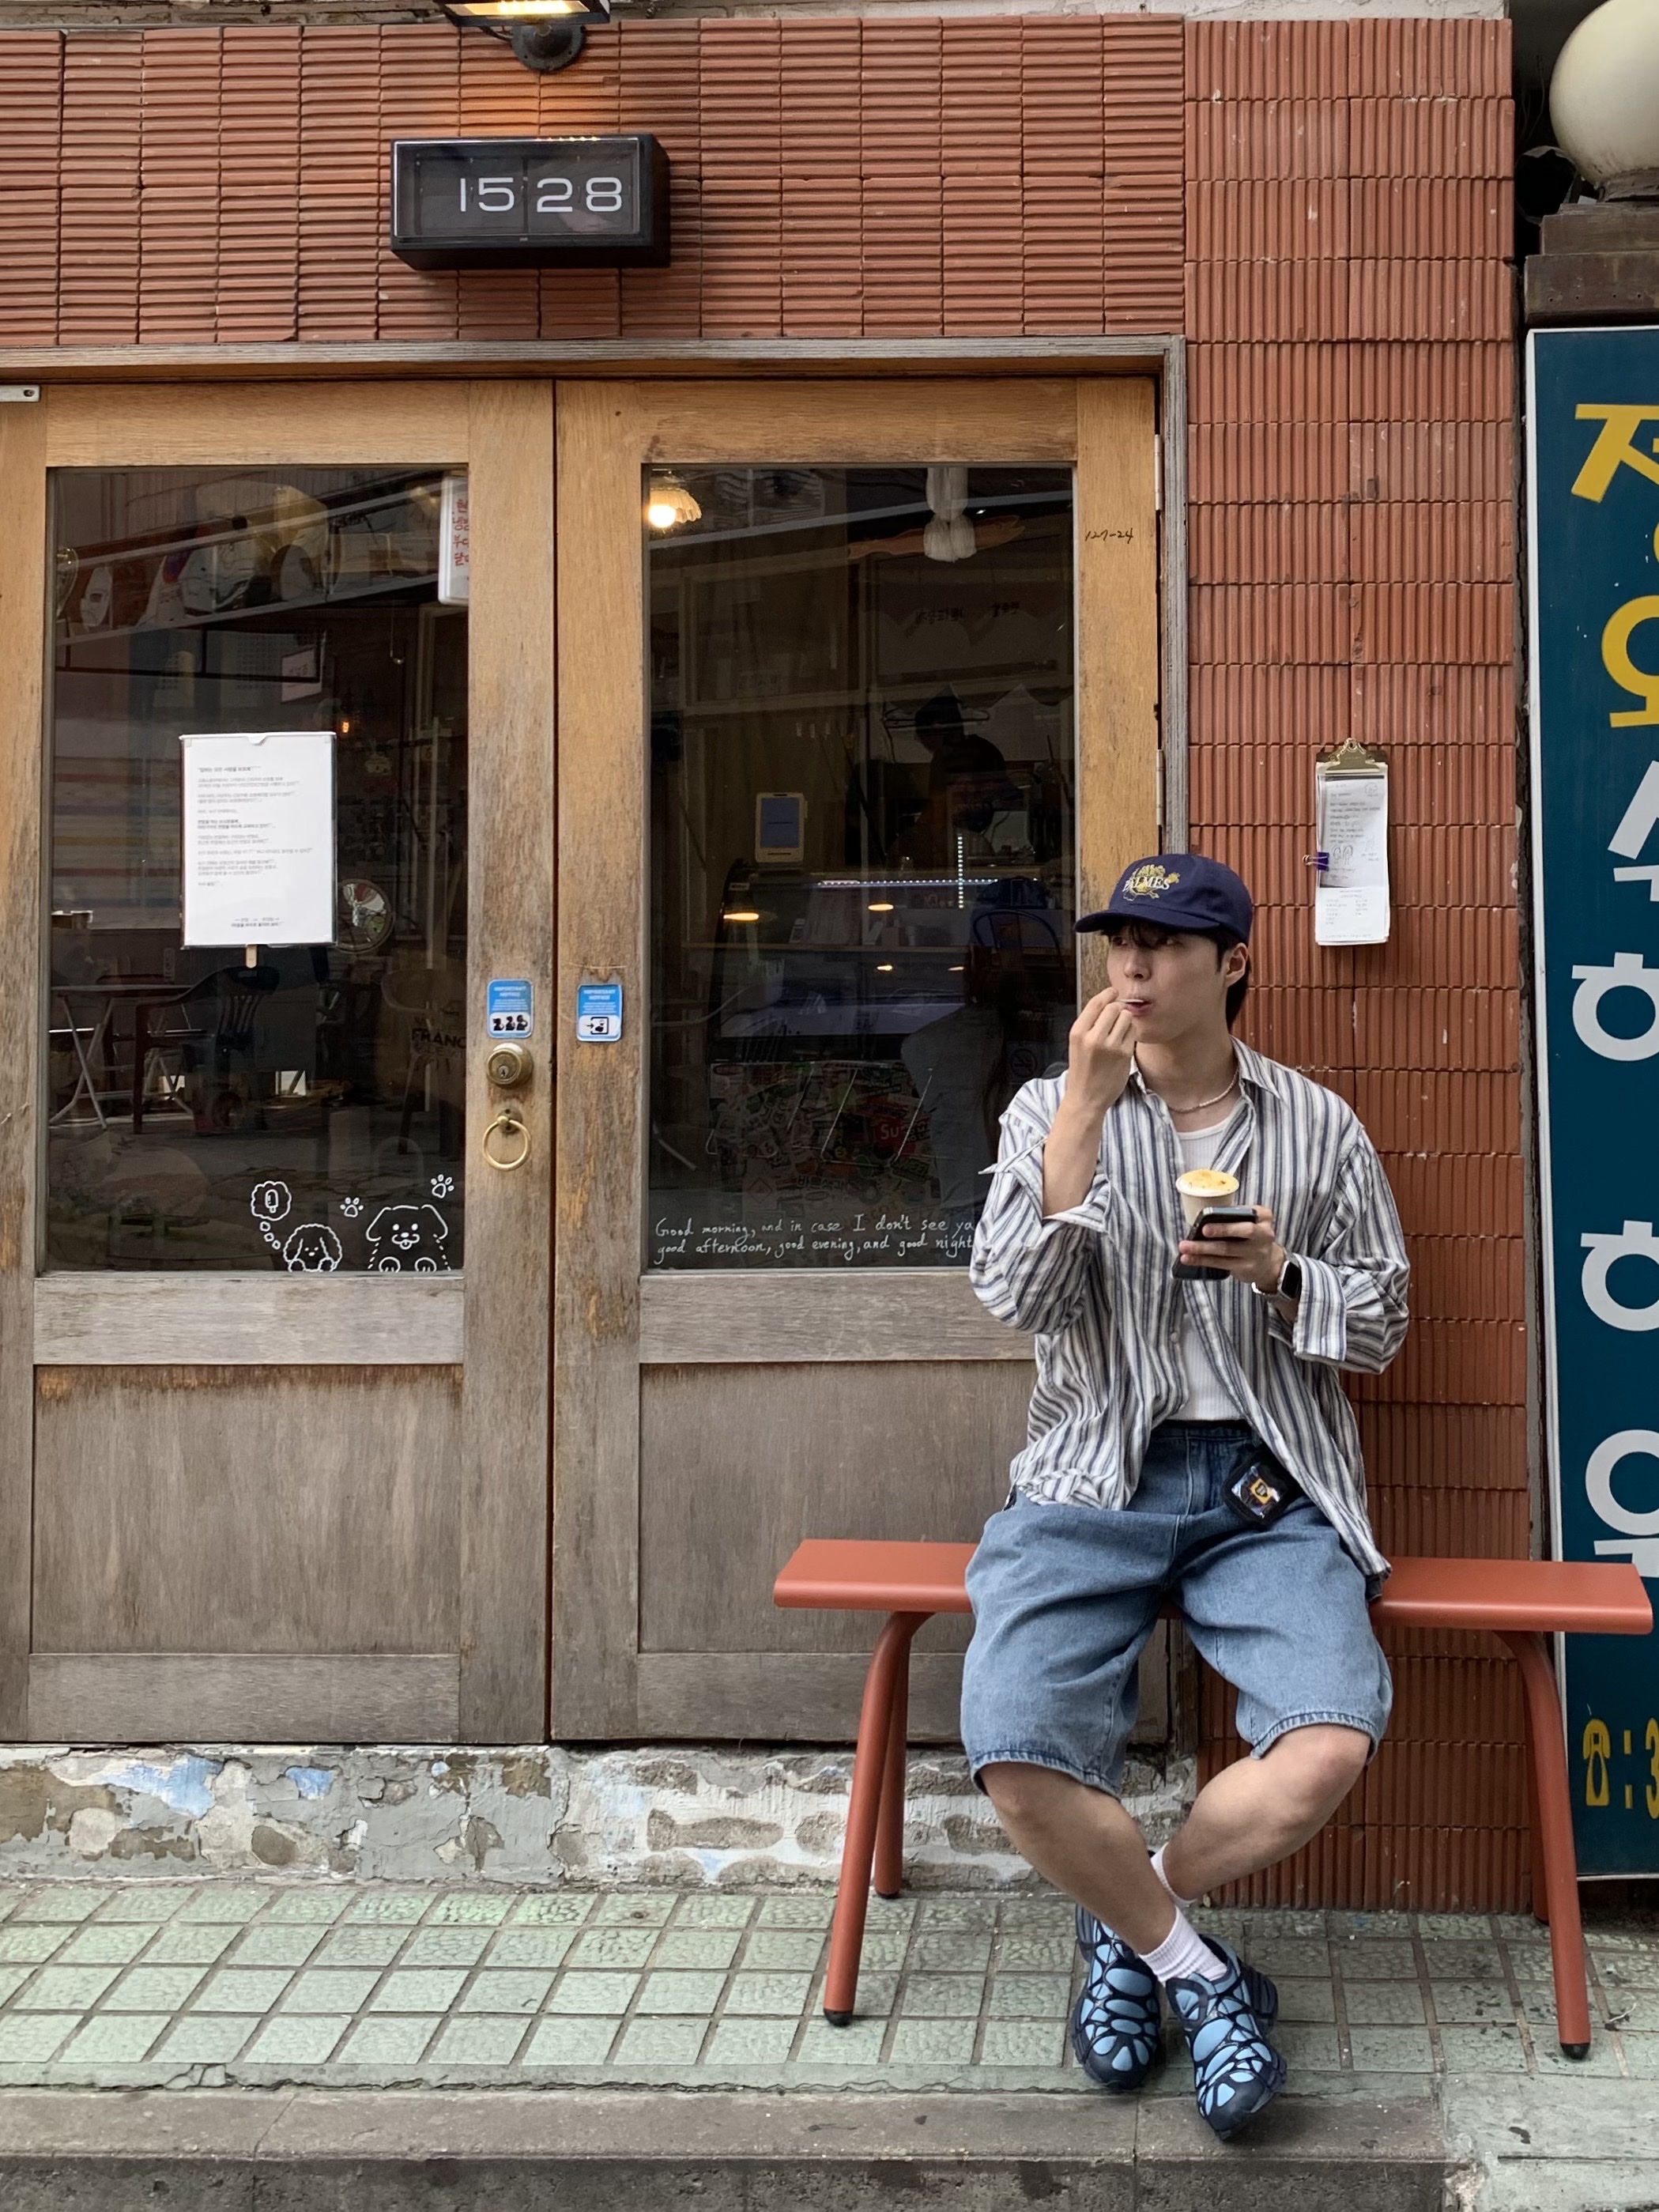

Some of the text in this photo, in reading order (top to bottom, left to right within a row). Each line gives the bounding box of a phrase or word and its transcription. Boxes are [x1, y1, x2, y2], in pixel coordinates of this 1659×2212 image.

[655, 1217, 694, 1237] Good
[701, 1223, 756, 1246] morning,
[761, 1218, 783, 1232] and
[790, 1220, 803, 1232] in
[811, 1222, 844, 1232] case
[852, 1214, 866, 1232] I
[875, 1214, 912, 1231] don't
[920, 1219, 948, 1231] see
[653, 1238, 687, 1265] good
[695, 1237, 771, 1256] afternoon,
[774, 1235, 805, 1259] good
[897, 1232, 929, 1257] good
